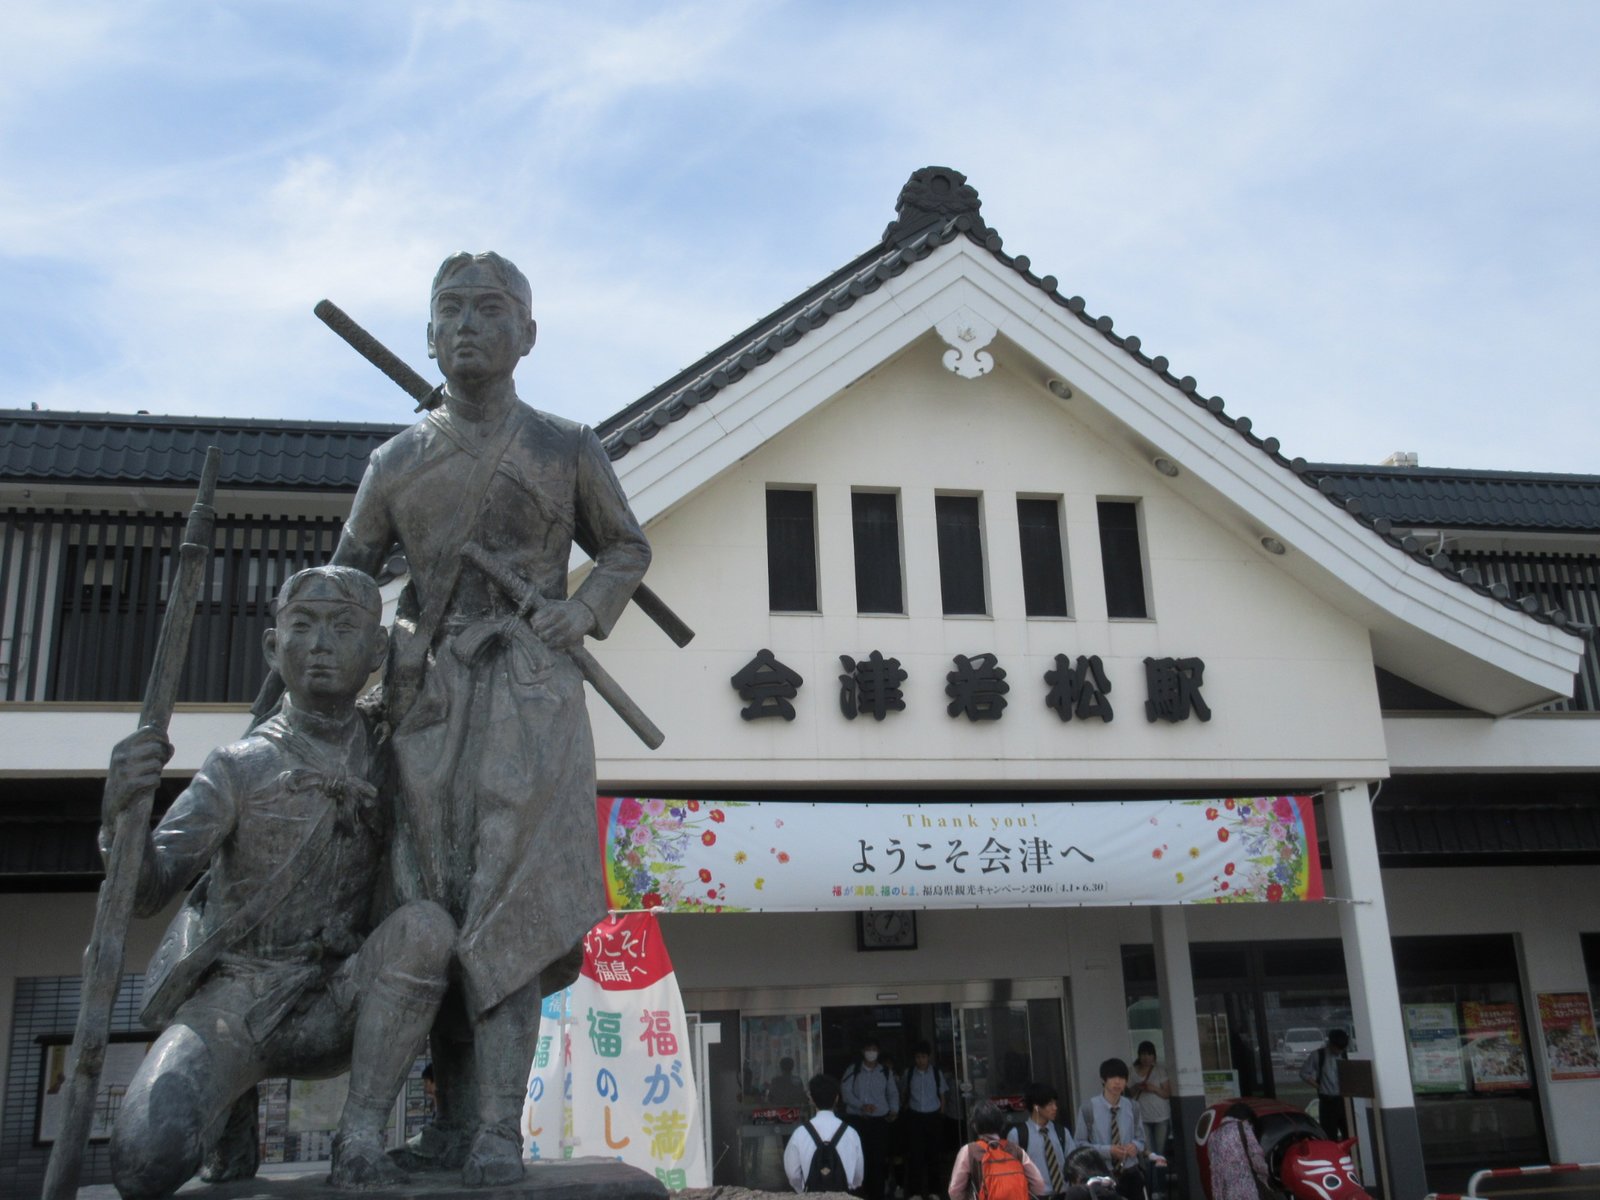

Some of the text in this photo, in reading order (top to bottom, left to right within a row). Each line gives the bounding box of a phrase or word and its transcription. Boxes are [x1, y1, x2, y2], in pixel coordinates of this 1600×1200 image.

[731, 648, 1212, 723] 会津若松駅
[903, 814, 1038, 831] Thank you!
[852, 837, 1096, 875] ようこそ会津へ
[594, 959, 648, 983] 福島へ
